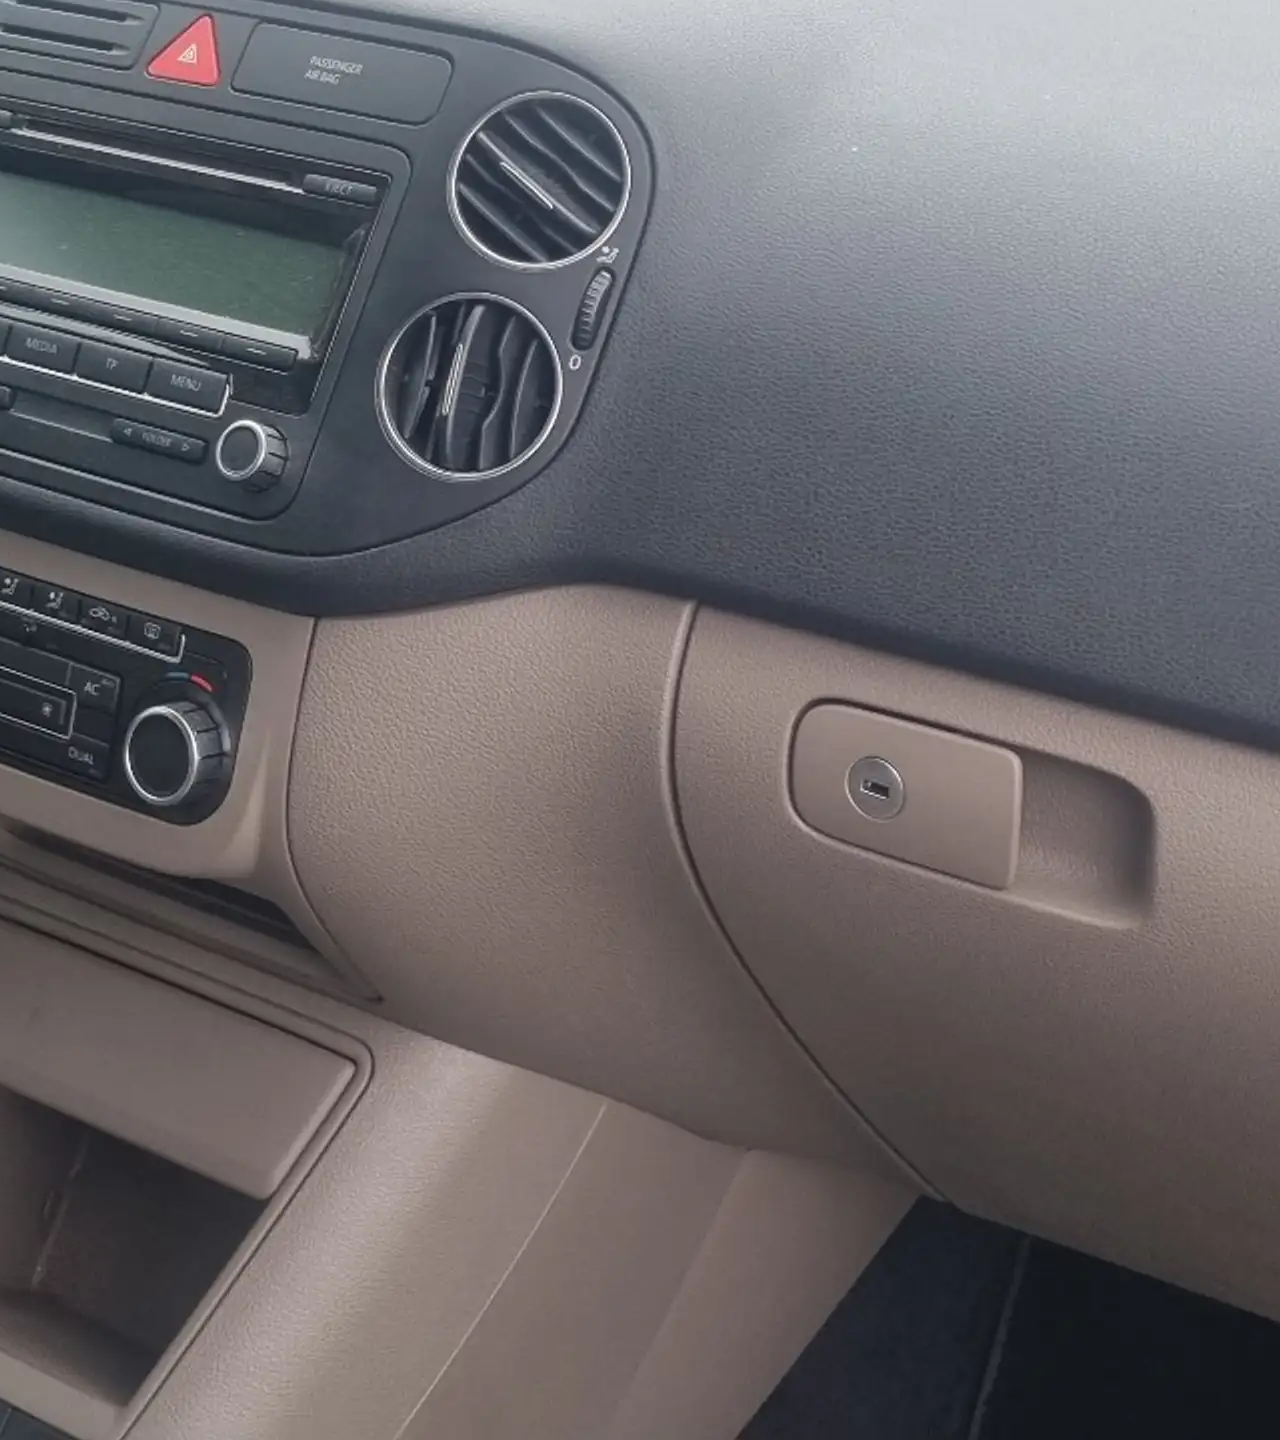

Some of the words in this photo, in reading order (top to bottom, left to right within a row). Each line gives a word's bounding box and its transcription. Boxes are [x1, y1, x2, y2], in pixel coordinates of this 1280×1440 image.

[308, 55, 363, 76] PASSENGER
[25, 337, 58, 354] MEDIA
[170, 373, 202, 392] MENU
[83, 681, 101, 696] AC
[68, 746, 94, 766] DUAL
